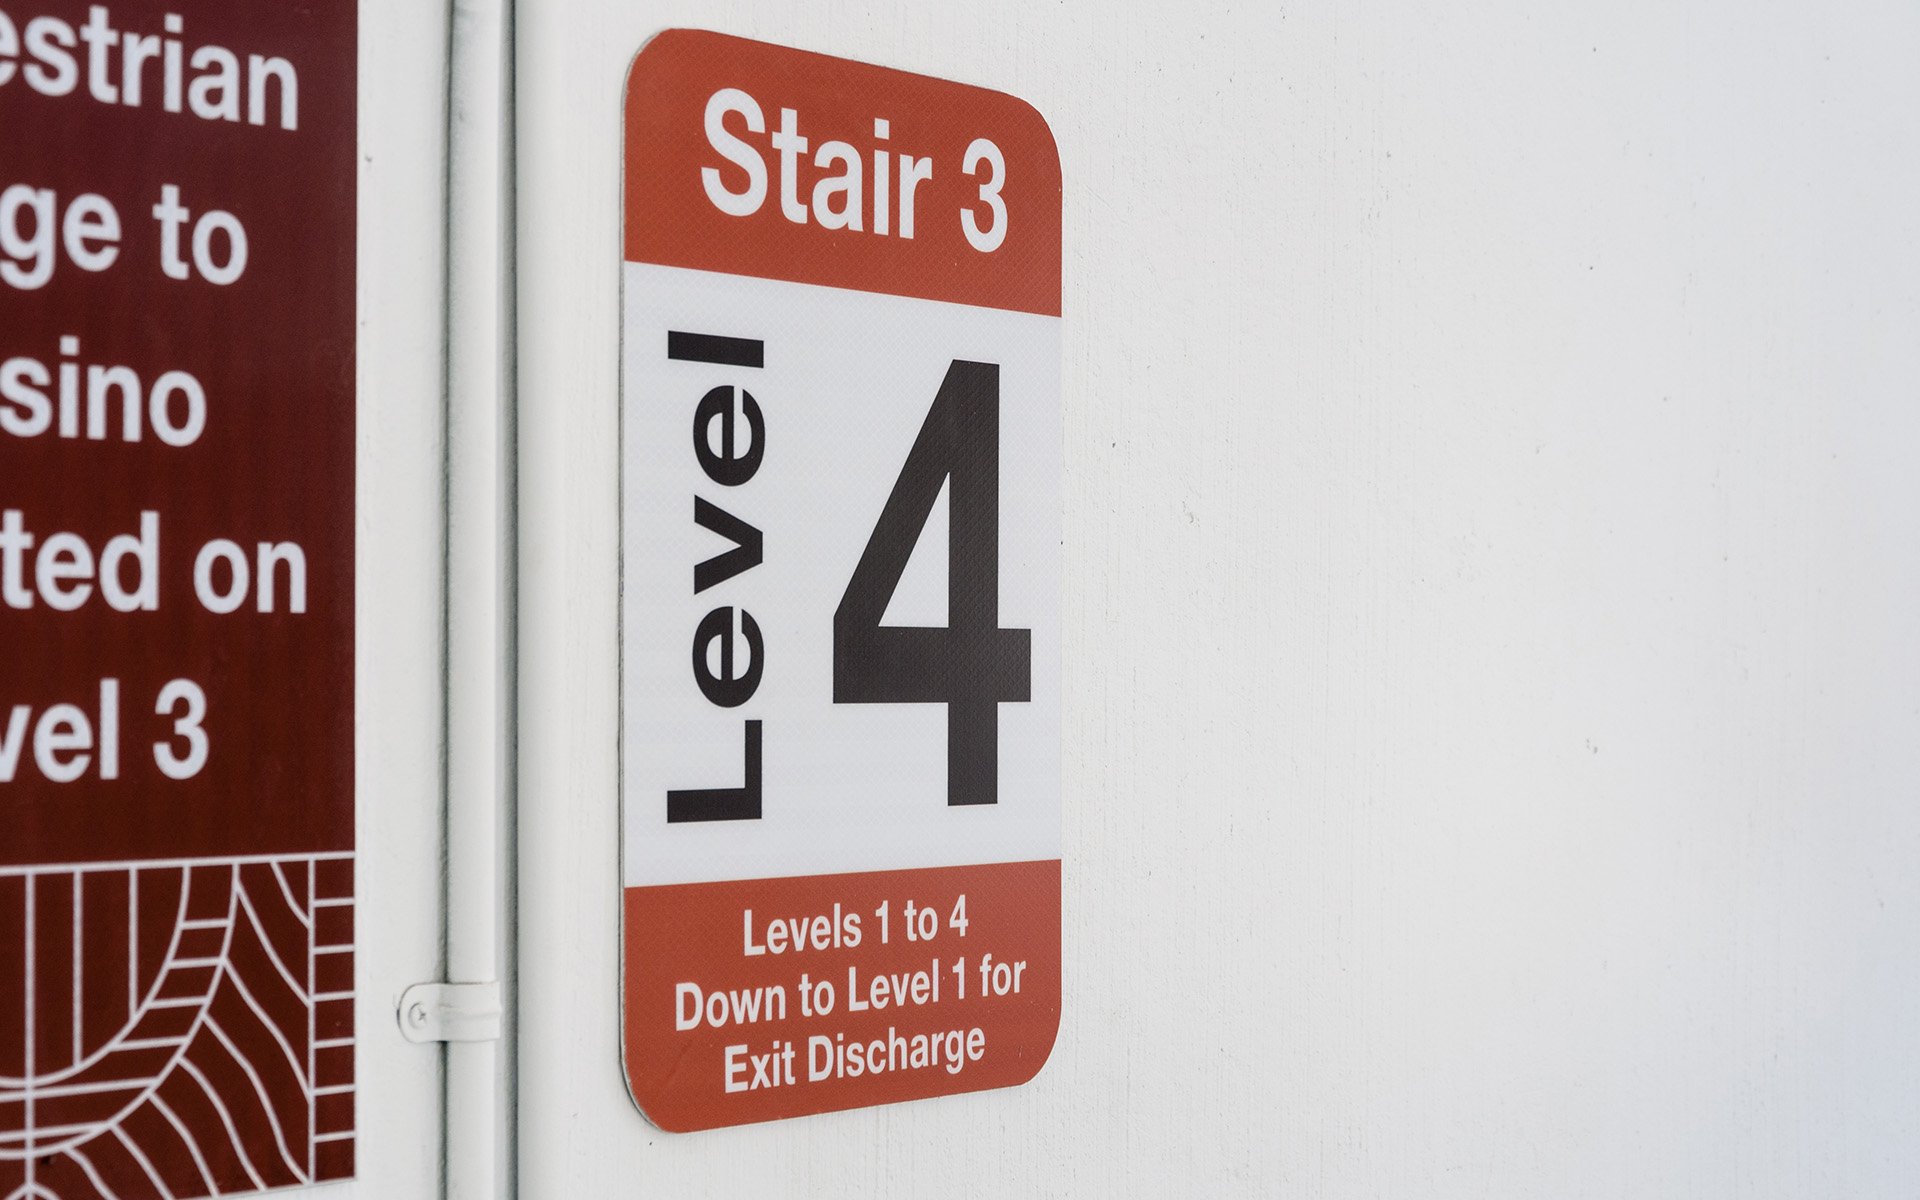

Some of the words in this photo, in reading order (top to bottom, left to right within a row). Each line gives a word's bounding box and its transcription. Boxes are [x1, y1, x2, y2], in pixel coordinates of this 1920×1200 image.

[701, 87, 933, 240] Stair
[959, 137, 1008, 253] 3
[0, 184, 121, 290] ge
[152, 184, 248, 286] to
[0, 335, 207, 447] sino
[0, 509, 159, 612] ted
[193, 538, 306, 614] on
[666, 330, 765, 824] Level
[832, 358, 1032, 807] 4
[152, 678, 209, 780] 3
[743, 902, 862, 957] Levels
[875, 899, 889, 944] 1
[903, 898, 939, 942] to
[948, 893, 969, 937] 4
[675, 981, 786, 1032] Down
[798, 973, 835, 1017] to
[848, 958, 939, 1012] Level
[952, 956, 965, 1000] 1
[979, 952, 1027, 997] for
[724, 1040, 796, 1094] Exit
[808, 1026, 986, 1083] Discharge
